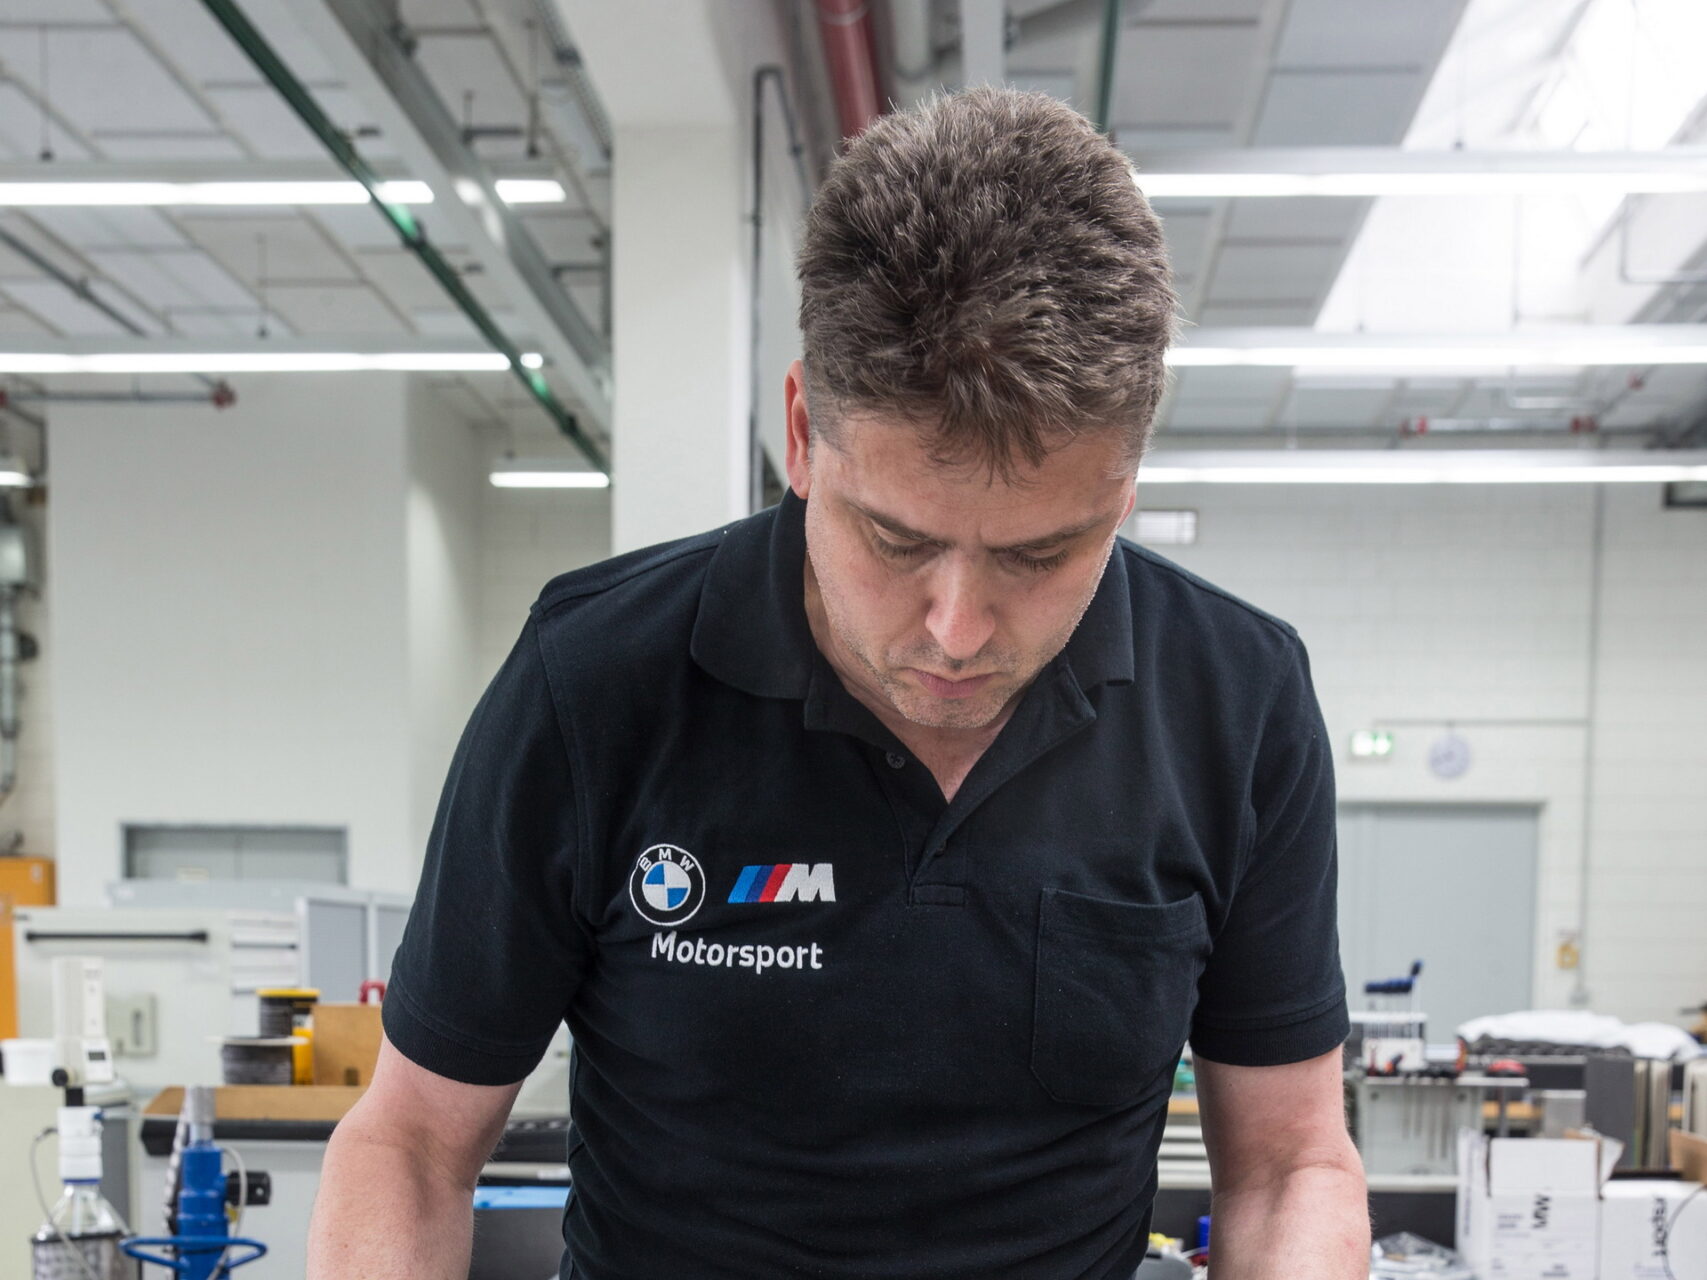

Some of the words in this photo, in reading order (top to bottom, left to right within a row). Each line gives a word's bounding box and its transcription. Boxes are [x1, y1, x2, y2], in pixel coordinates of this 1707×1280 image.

[639, 847, 695, 872] BMW
[774, 862, 837, 904] M
[650, 930, 823, 975] Motorsport
